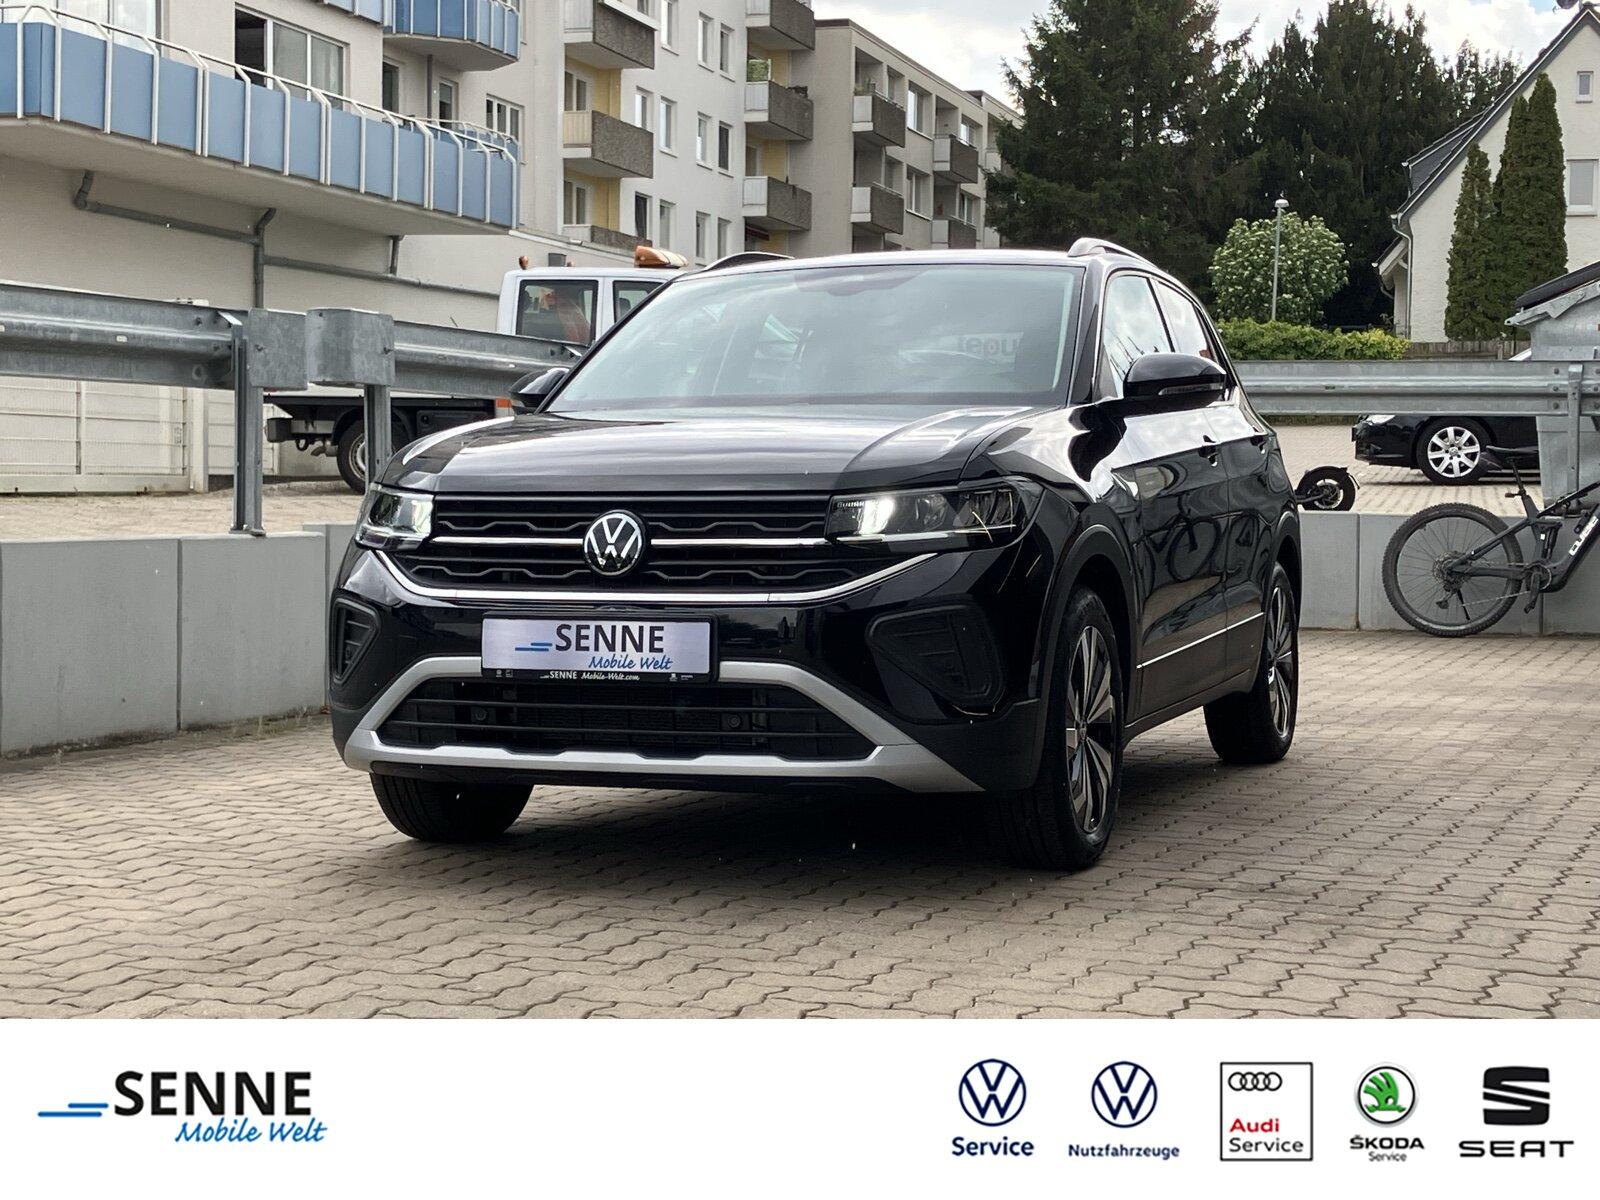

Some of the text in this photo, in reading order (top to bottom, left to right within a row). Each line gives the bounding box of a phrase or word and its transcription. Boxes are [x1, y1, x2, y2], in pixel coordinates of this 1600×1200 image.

[555, 623, 665, 653] SENNE
[588, 653, 673, 670] Mobile Welt
[549, 670, 578, 680] SENNE
